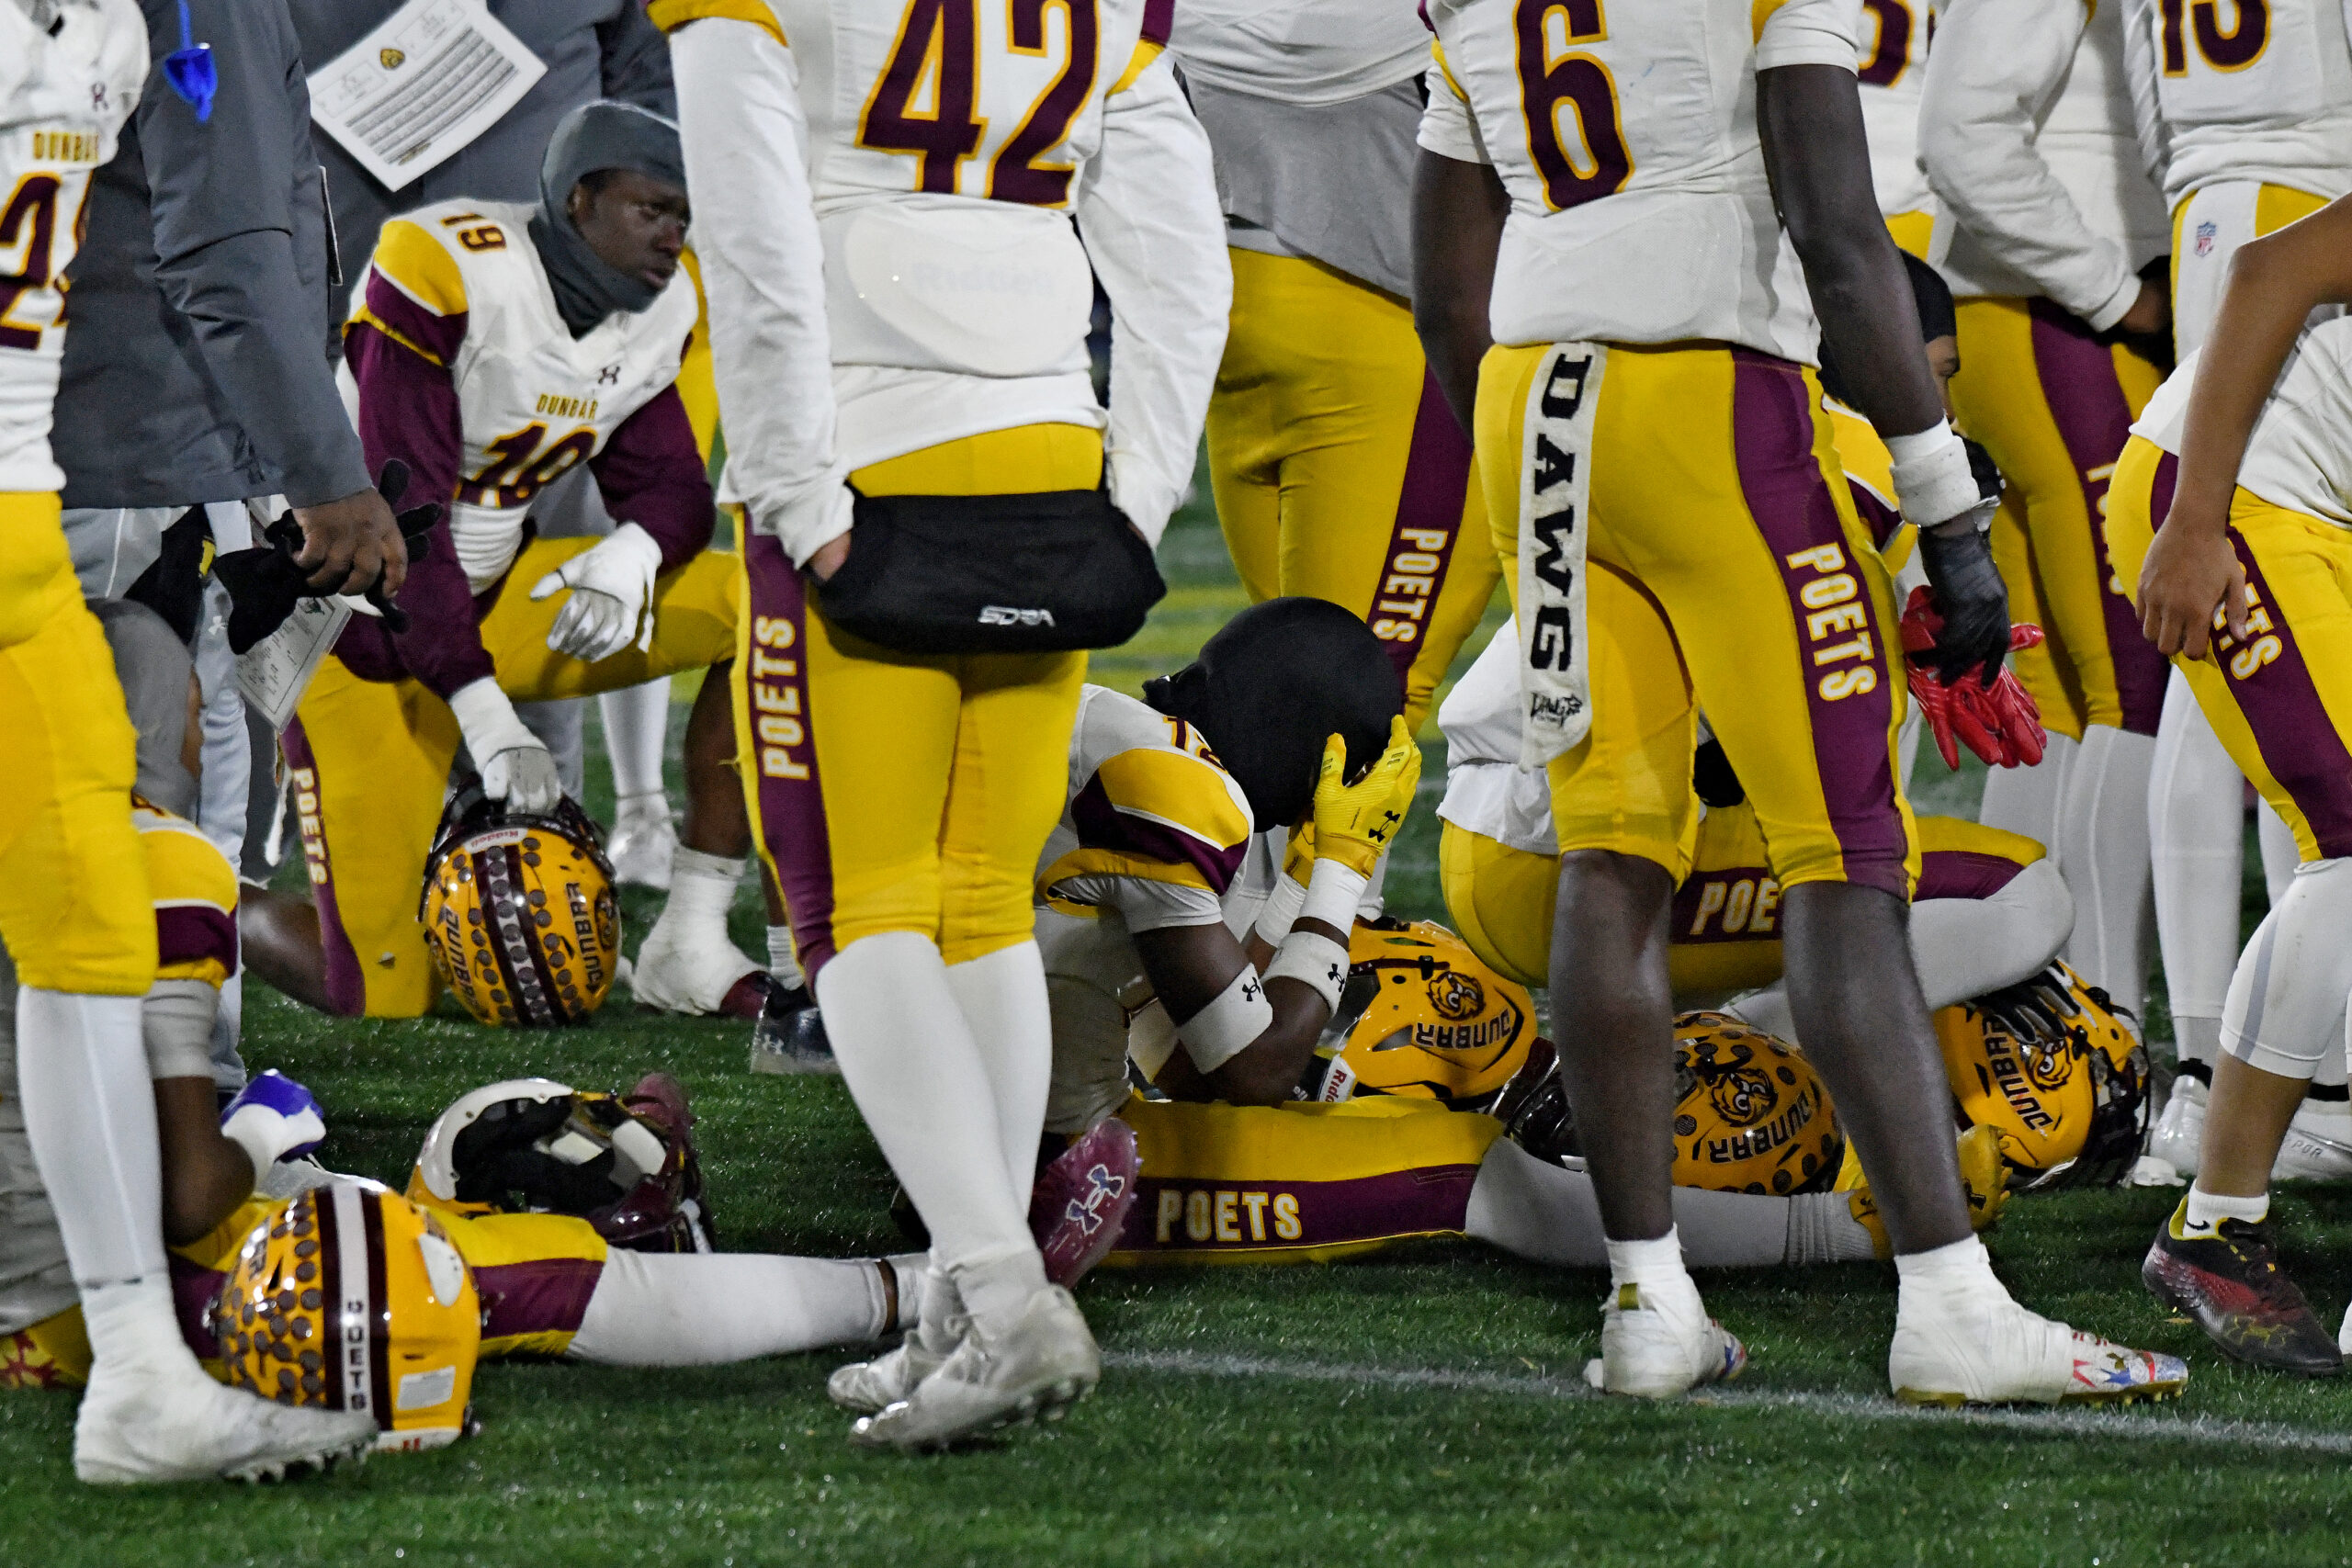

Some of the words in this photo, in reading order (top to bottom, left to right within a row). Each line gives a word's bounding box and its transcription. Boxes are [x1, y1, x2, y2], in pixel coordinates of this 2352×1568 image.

[854, 0, 1102, 210] 42
[1512, 0, 1636, 213] 6
[440, 213, 507, 253] 19
[537, 393, 598, 419] DUNBAR
[1534, 353, 1592, 671] DAWG
[1373, 528, 1449, 642] POETS
[1786, 542, 1878, 701] POETS
[753, 615, 809, 780] POETS
[294, 768, 328, 885] POETS
[1414, 1010, 1513, 1050] DUNBAR
[1707, 1089, 1814, 1164] DUNBAR
[1156, 1189, 1303, 1242] POETS
